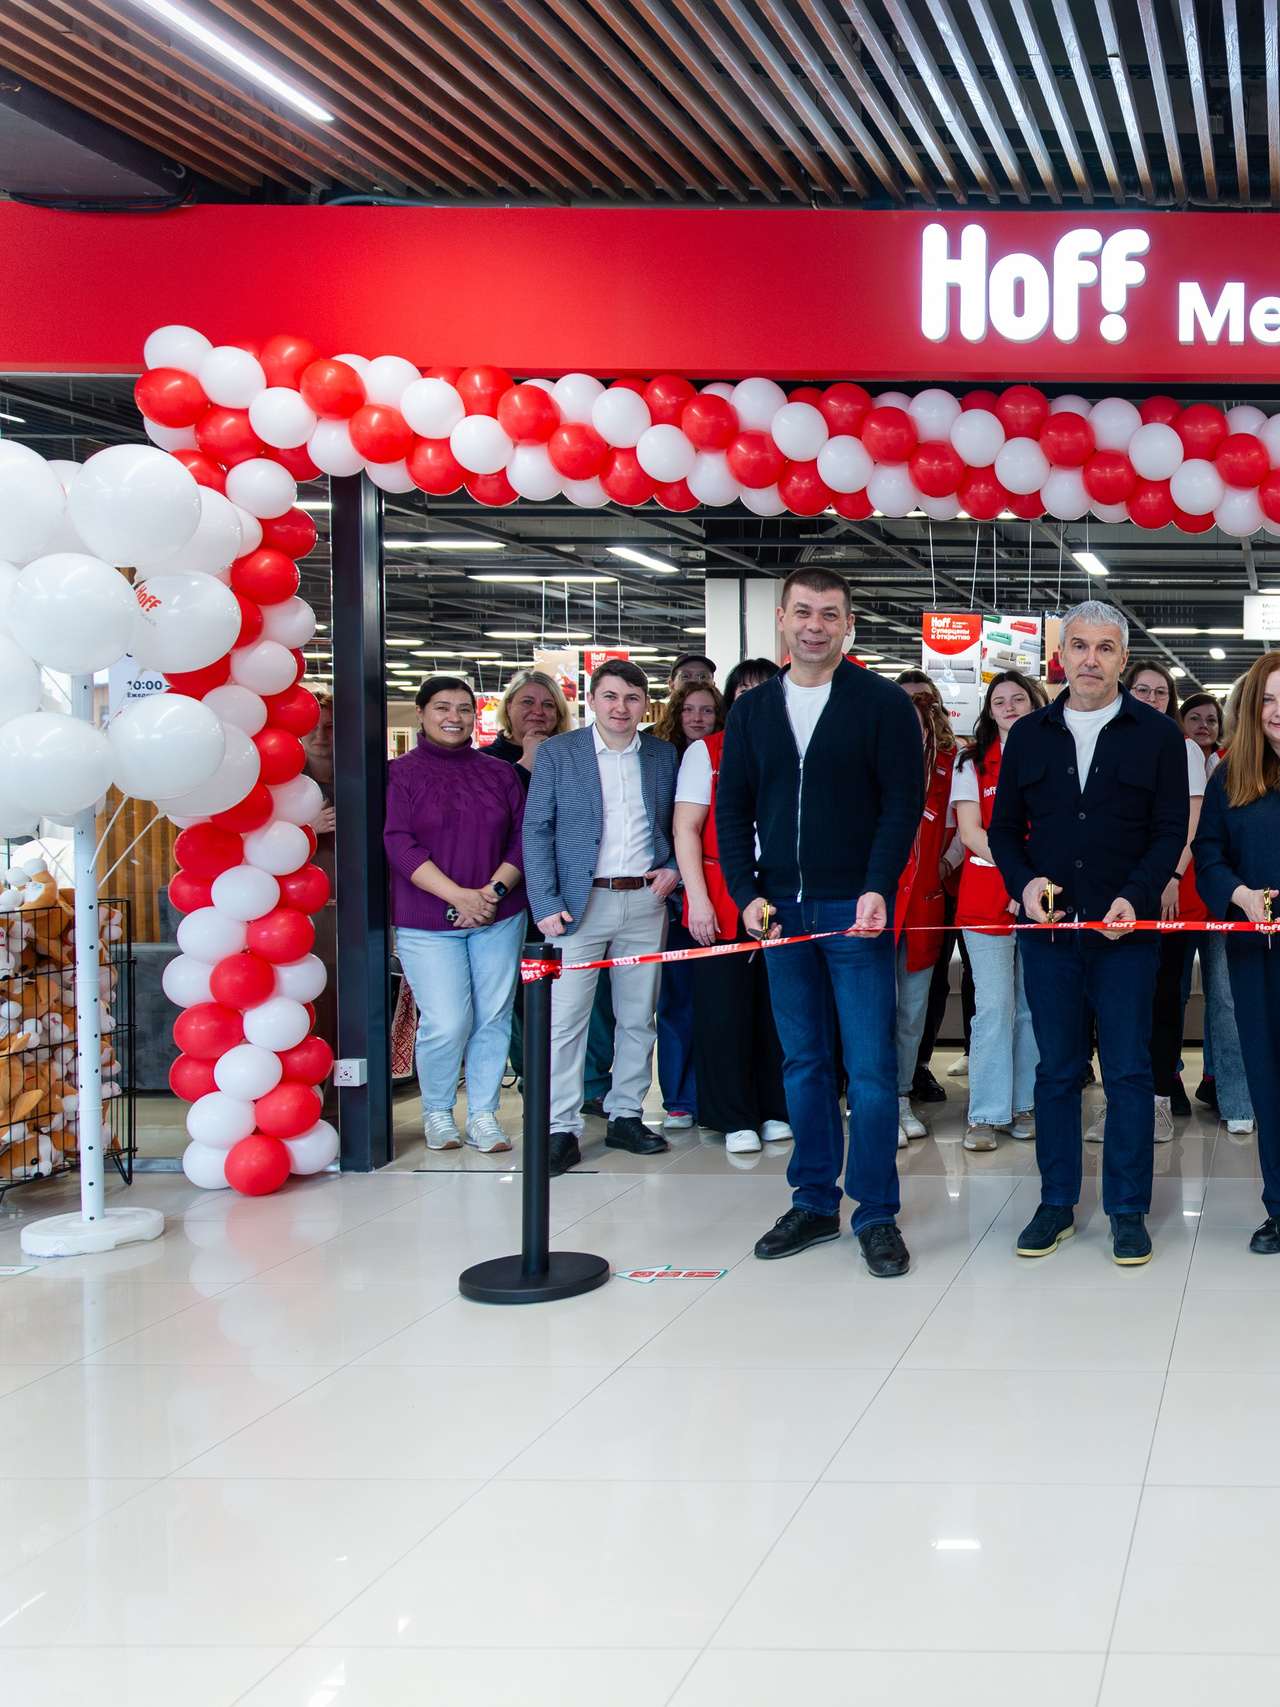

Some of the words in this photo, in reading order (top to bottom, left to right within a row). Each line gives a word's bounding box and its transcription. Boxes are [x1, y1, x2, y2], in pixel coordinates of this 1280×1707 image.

[921, 223, 1151, 344] Hoff
[931, 616, 951, 628] Hoff
[127, 680, 163, 691] 10:00
[1206, 922, 1235, 930] Hoff
